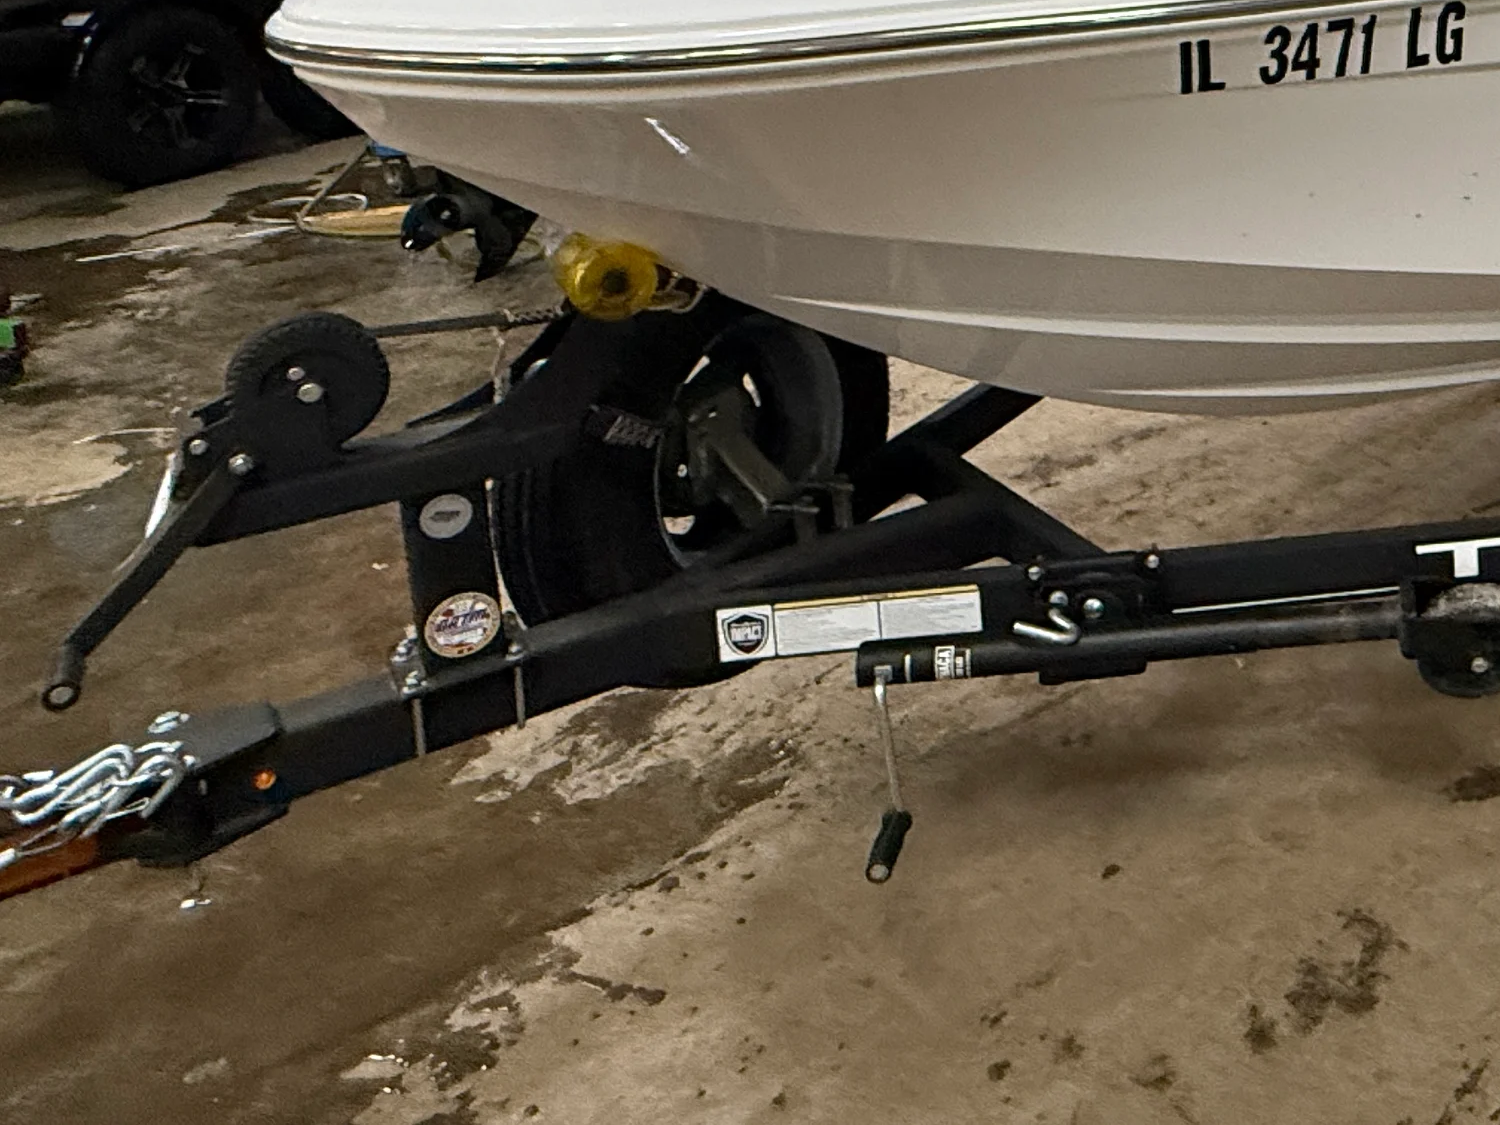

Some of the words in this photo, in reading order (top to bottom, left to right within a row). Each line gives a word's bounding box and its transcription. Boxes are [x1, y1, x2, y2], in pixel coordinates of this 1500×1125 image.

[1179, 38, 1226, 94] IL
[1259, 14, 1378, 86] 3471
[1406, 0, 1466, 69] LG
